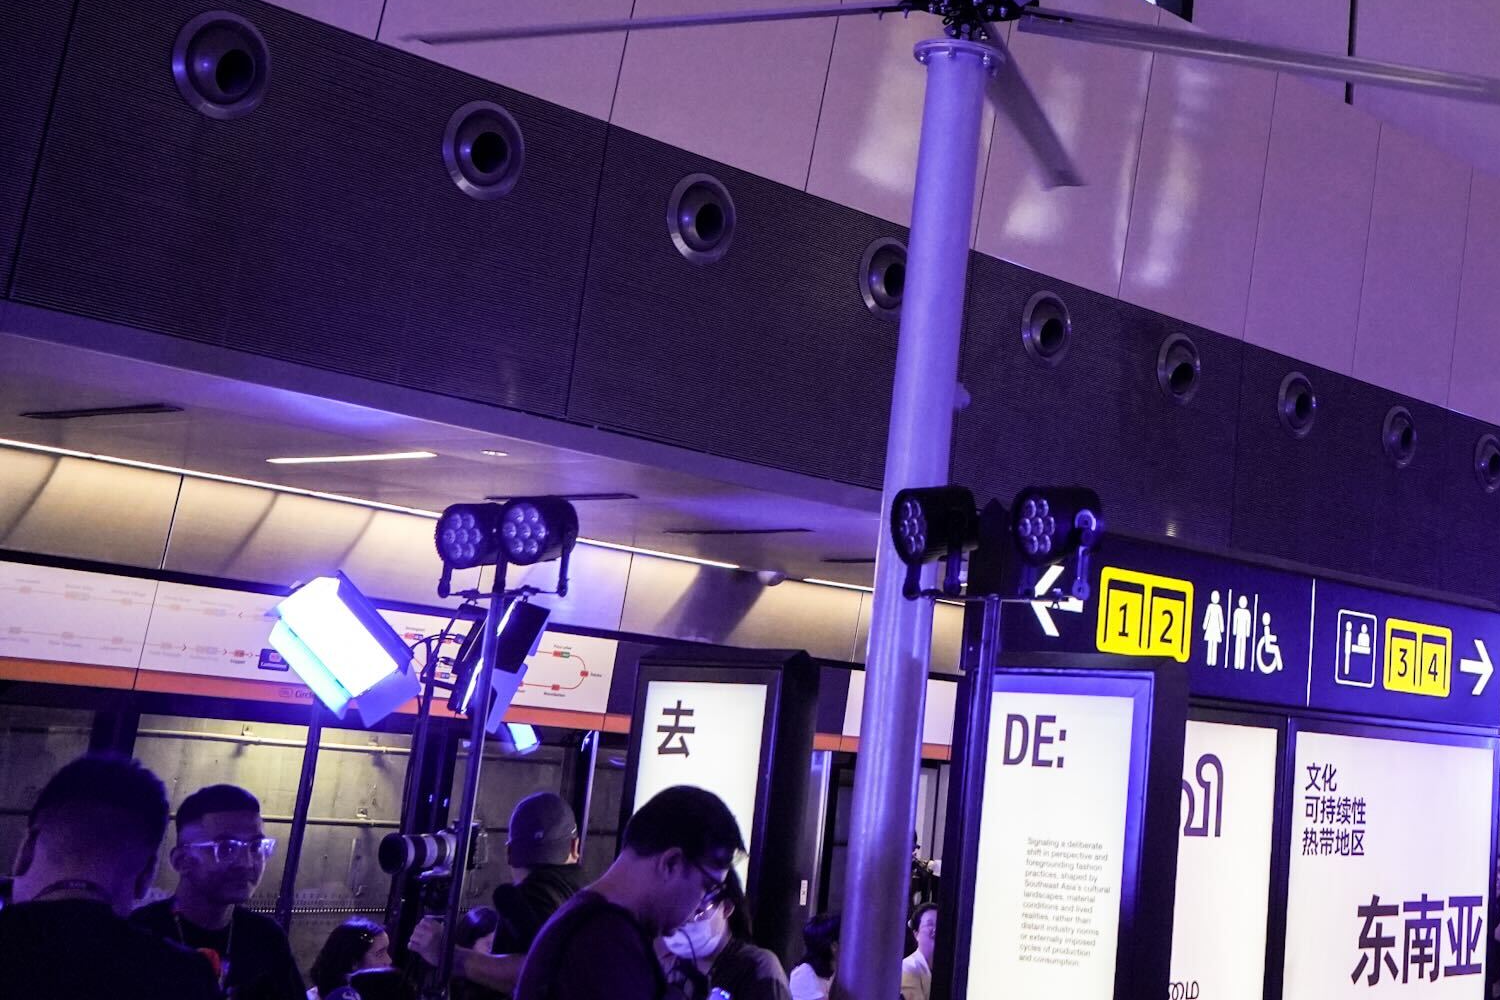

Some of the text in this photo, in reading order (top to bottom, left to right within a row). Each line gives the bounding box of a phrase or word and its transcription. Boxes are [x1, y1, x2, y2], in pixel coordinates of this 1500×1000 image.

[1118, 603, 1174, 645] 1 2
[1397, 648, 1440, 682] 3 4
[656, 700, 695, 759] 去
[1002, 712, 1067, 769] DE:
[1305, 762, 1338, 792] 文化
[1304, 796, 1366, 825] 可持续性
[1302, 827, 1365, 857] 热带地区
[1350, 893, 1484, 987] 东南亚
